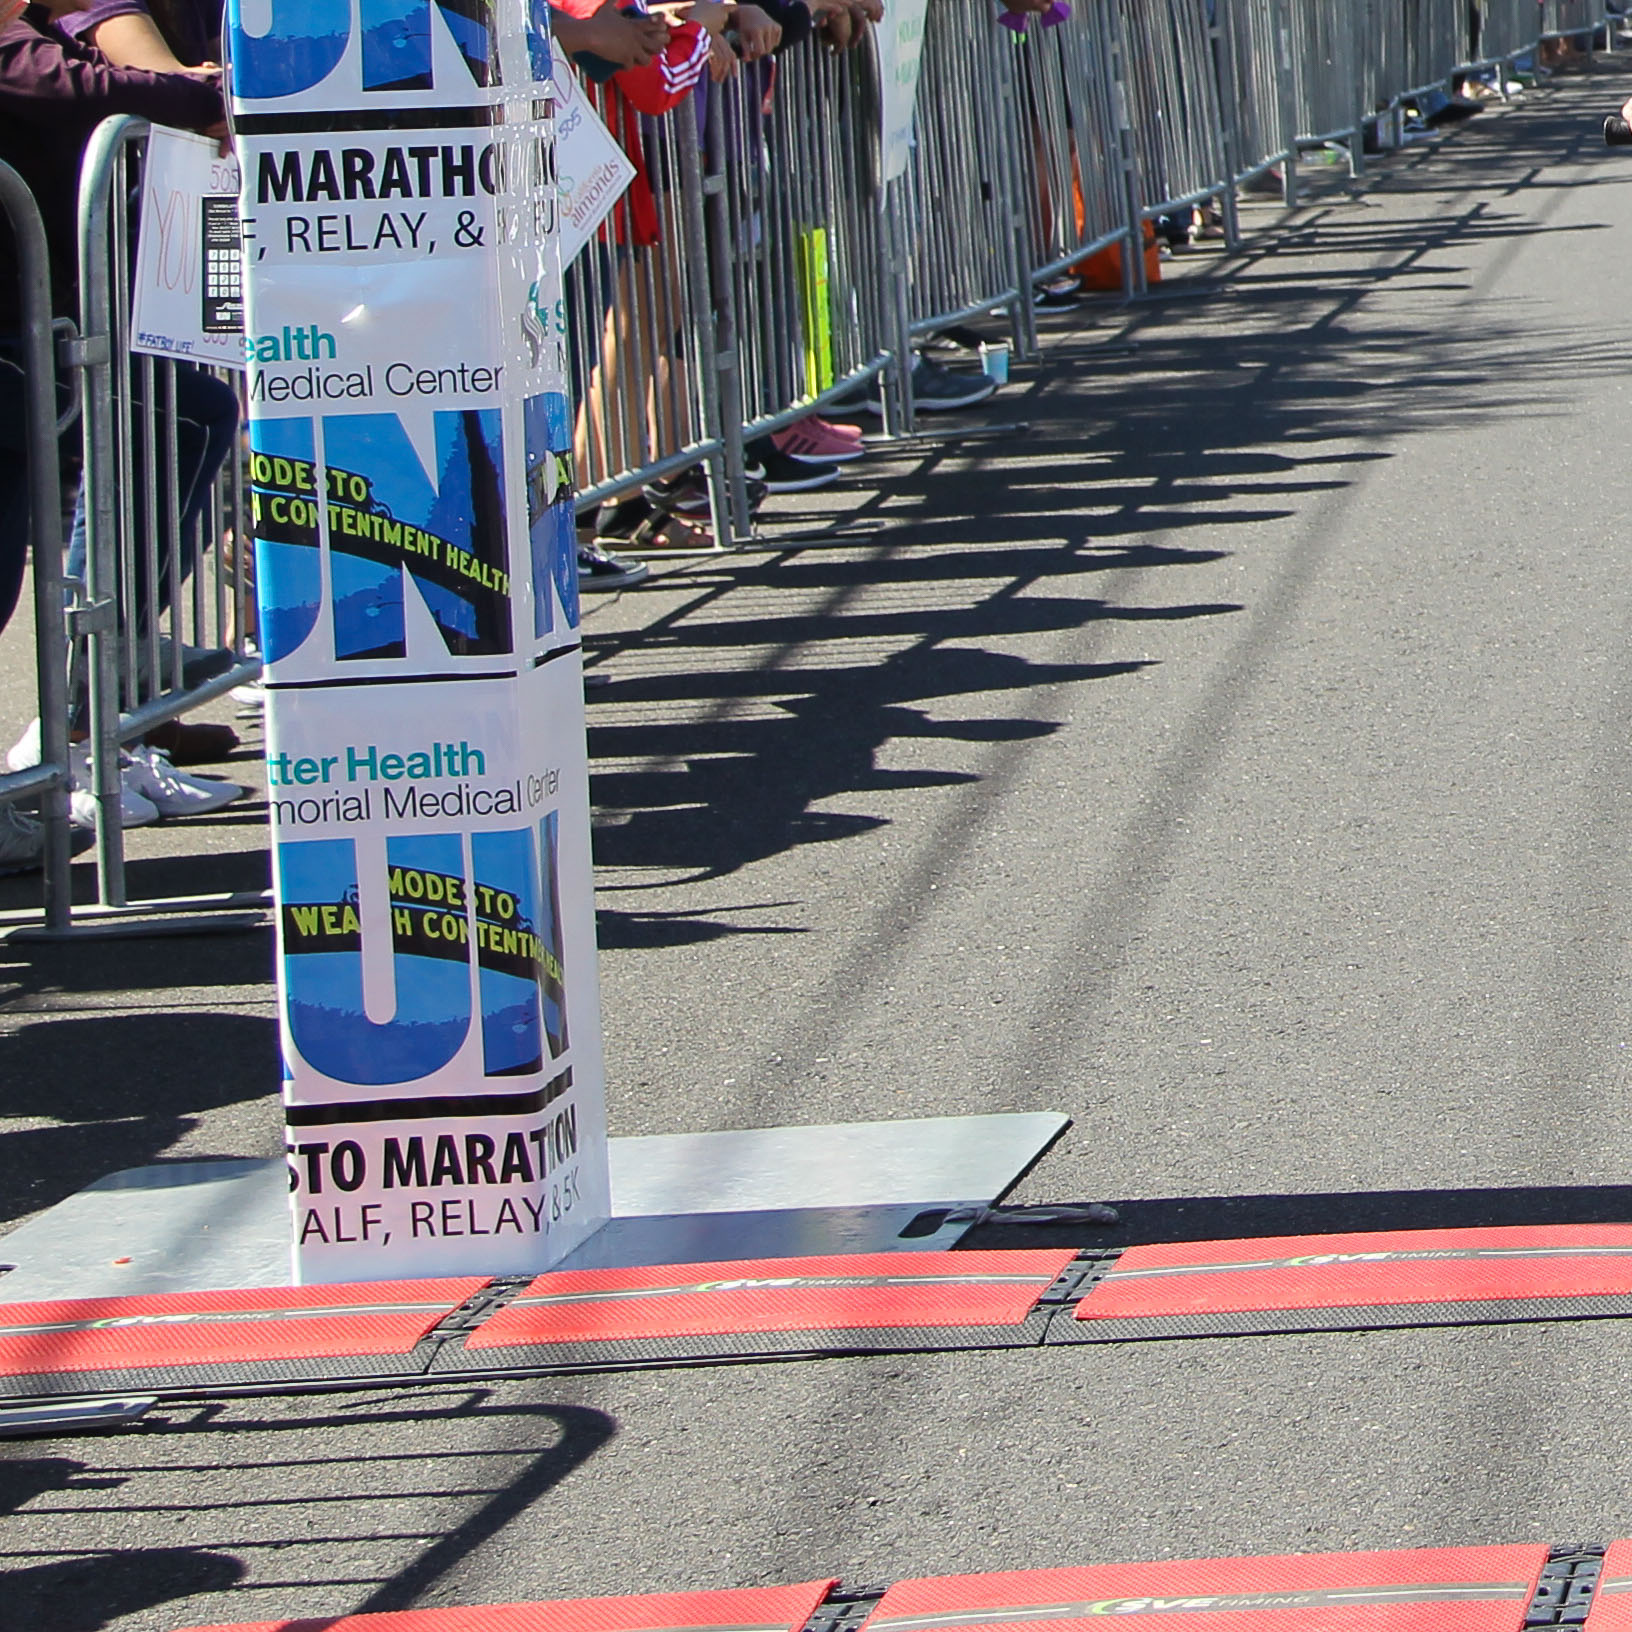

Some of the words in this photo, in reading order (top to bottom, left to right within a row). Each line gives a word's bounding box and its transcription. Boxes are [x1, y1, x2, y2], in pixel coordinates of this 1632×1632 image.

[558, 107, 582, 141] 505
[569, 158, 620, 229] almonds
[152, 187, 201, 295] YOU
[286, 212, 437, 255] RELAY,
[453, 209, 486, 248] &
[385, 363, 504, 398] Center
[347, 740, 486, 783] Health
[383, 781, 523, 821] Medical
[382, 1103, 578, 1192] MARATHON
[411, 1193, 550, 1238] RELAY,
[1116, 1596, 1216, 1616] SVE
